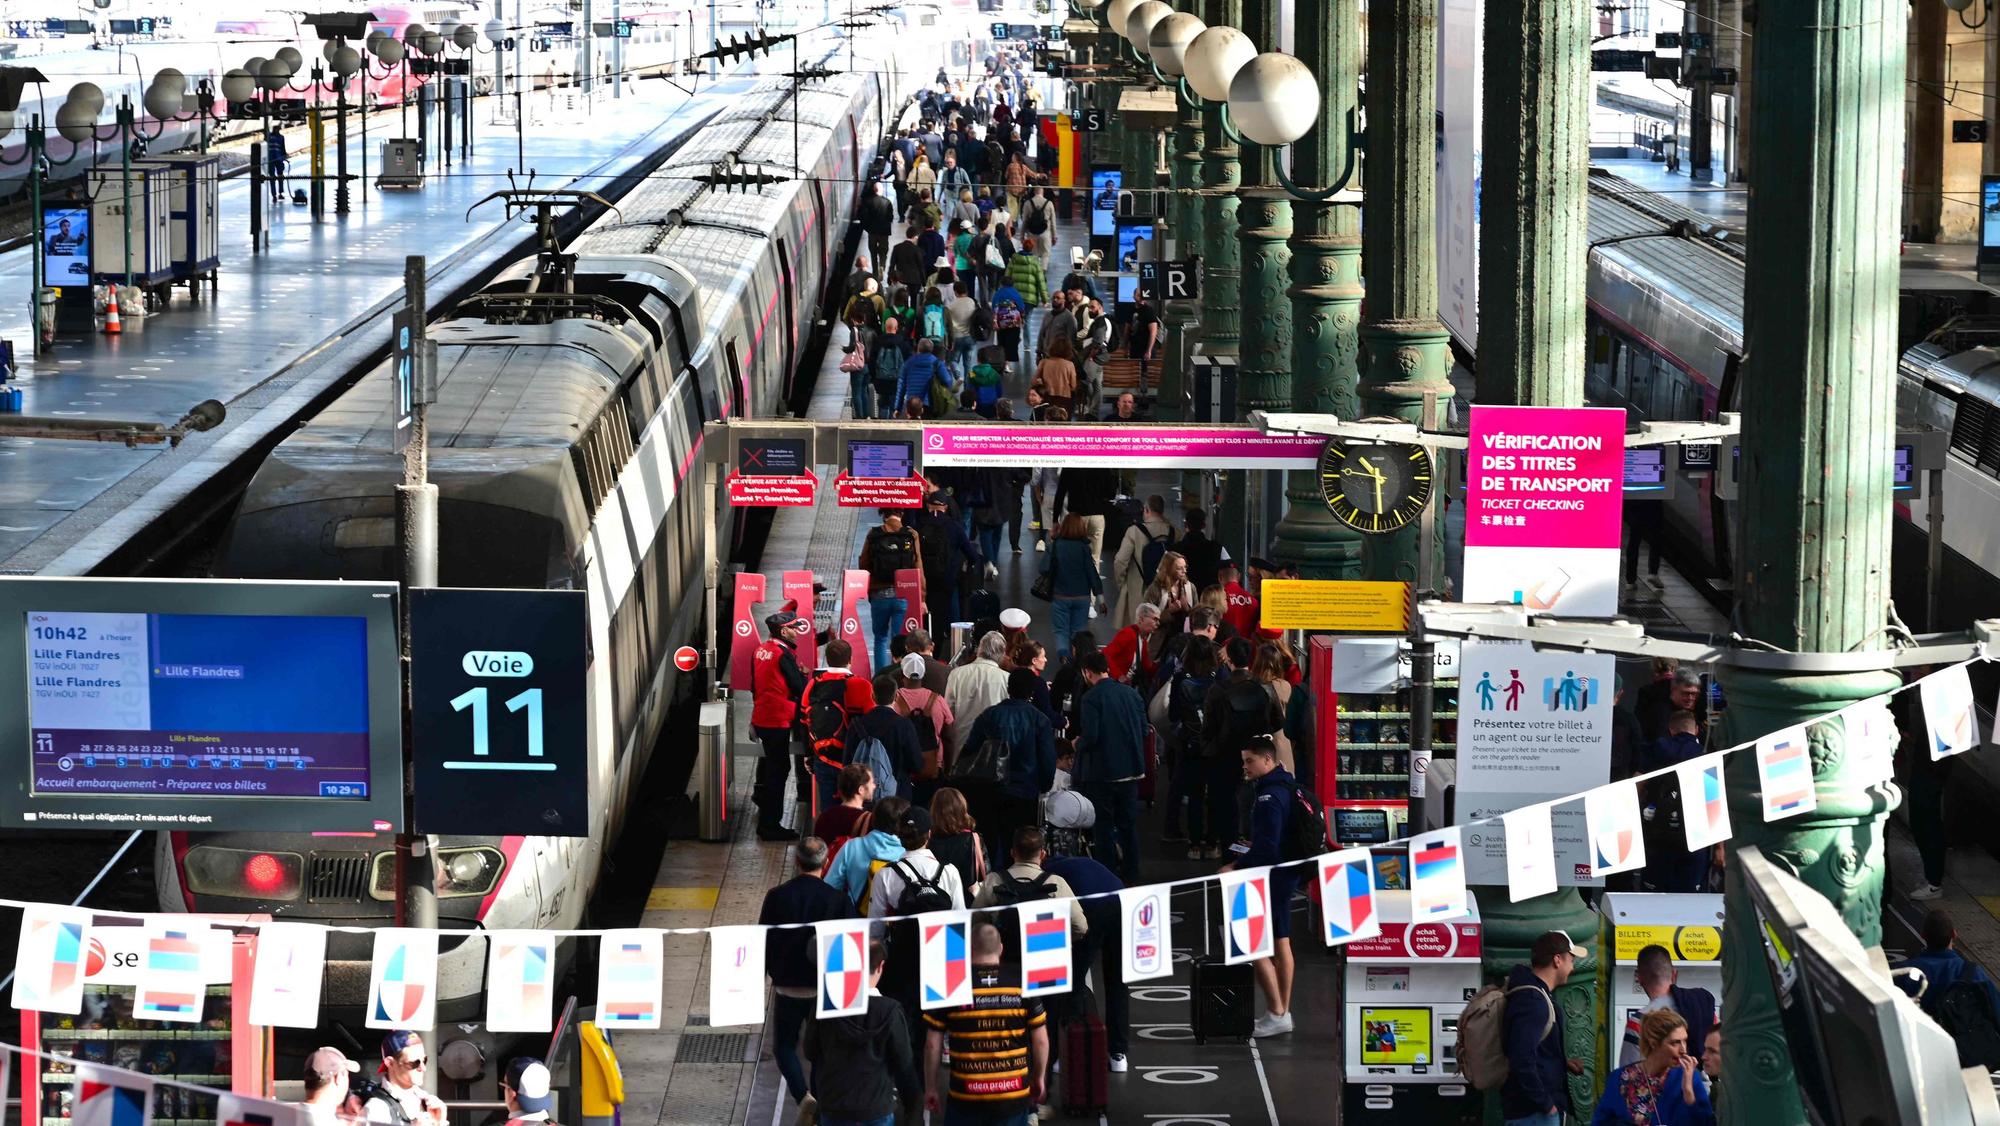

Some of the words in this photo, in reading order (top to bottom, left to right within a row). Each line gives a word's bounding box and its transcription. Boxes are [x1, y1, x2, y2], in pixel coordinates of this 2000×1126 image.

[616, 25, 629, 35] 10
[994, 27, 1006, 37] 11
[1049, 29, 1062, 38] 11
[1088, 114, 1100, 130] S
[1970, 126, 1980, 141] S
[1142, 268, 1155, 278] 11
[1168, 270, 1188, 297] R
[398, 354, 411, 416] 11
[1482, 432, 1602, 450] VÉRIFICATION
[1482, 456, 1516, 470] DES
[1520, 456, 1576, 471] TITRES
[1481, 476, 1505, 490] DE
[1510, 477, 1613, 492] TRANSPORT
[1481, 499, 1522, 509] TICKET
[1523, 500, 1584, 511] CHECKING
[741, 583, 758, 591] Accès
[786, 582, 810, 590] Express
[897, 581, 918, 589] Express
[34, 626, 87, 640] 10h42
[34, 649, 62, 659] Lille
[66, 650, 120, 660] Flandres
[34, 662, 50, 670] TGV
[471, 654, 523, 673] Voie
[165, 666, 190, 676] Lille
[192, 666, 240, 677] Flandres
[36, 676, 63, 686] Lille
[67, 677, 121, 687] Flandres
[449, 686, 544, 757] 11
[1473, 719, 1526, 729] Présentez
[1528, 721, 1554, 729] votre
[1558, 720, 1584, 729] billet
[1587, 720, 1593, 730] à
[1473, 734, 1486, 742] un
[1488, 734, 1517, 744] agent
[1520, 734, 1533, 742] ou
[1554, 733, 1563, 742] le
[1566, 734, 1602, 742] lecteur
[36, 738, 53, 751] 11
[86, 758, 94, 766] R
[119, 758, 125, 766] S
[143, 759, 149, 767] T
[163, 759, 169, 767] U
[189, 759, 196, 767] V
[212, 760, 220, 768] W
[232, 760, 240, 768] X
[267, 761, 274, 769] Y
[297, 761, 303, 769] Z
[36, 777, 74, 788] Accueil
[76, 778, 156, 789] embarquement
[167, 780, 212, 790] Préparez
[214, 782, 232, 790] vos
[234, 781, 266, 790] billets
[39, 812, 71, 820] Présence
[73, 812, 77, 820] à
[79, 812, 94, 822] quai
[96, 812, 134, 822] obligatoire
[142, 813, 156, 821] min
[157, 814, 177, 822] avant
[179, 813, 186, 822] le
[188, 814, 212, 823] départ
[1416, 944, 1446, 952] échange
[978, 1019, 1005, 1027] TRIPLE
[972, 1040, 1010, 1049] COUNTY
[968, 1082, 988, 1090] eden
[990, 1080, 1019, 1090] project
